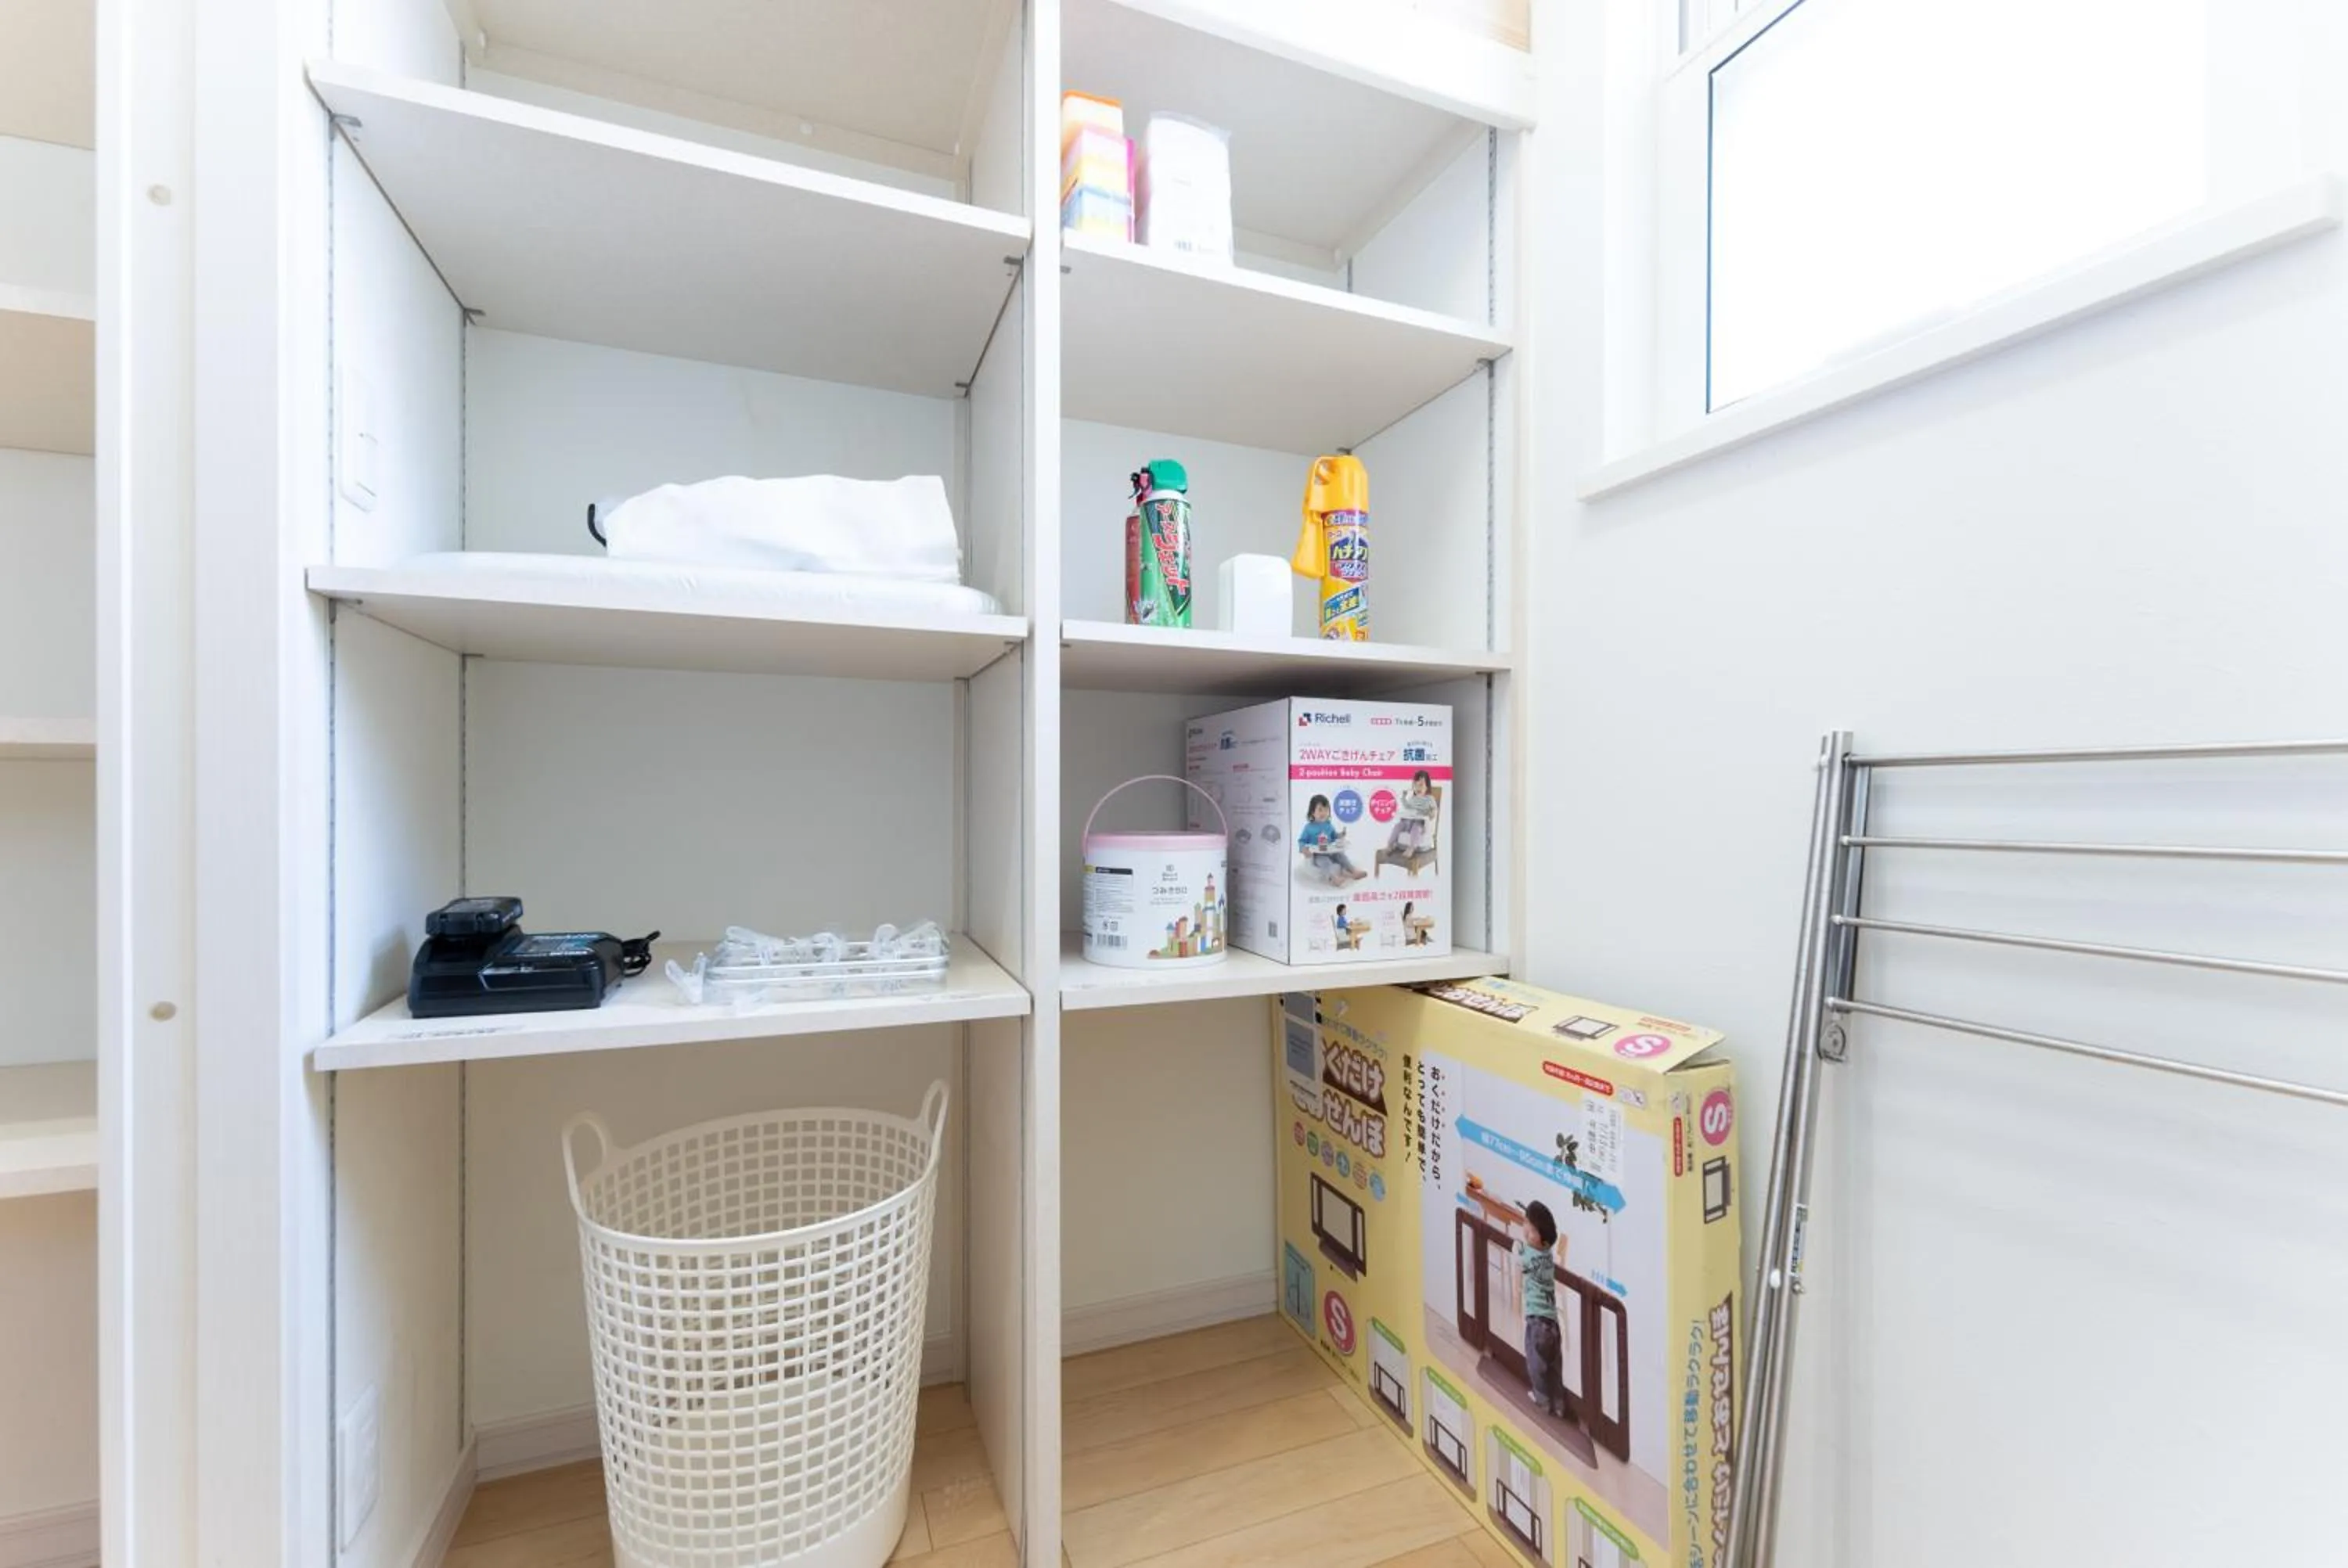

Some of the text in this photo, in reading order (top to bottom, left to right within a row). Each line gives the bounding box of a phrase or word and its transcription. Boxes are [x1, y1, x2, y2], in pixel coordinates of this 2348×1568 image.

[1314, 713, 1352, 724] Richell
[1298, 749, 1395, 761] 2WAYごきげんチェア
[1322, 1038, 1386, 1105] くだけ
[1704, 1102, 1727, 1135] S
[1328, 1296, 1349, 1335] S
